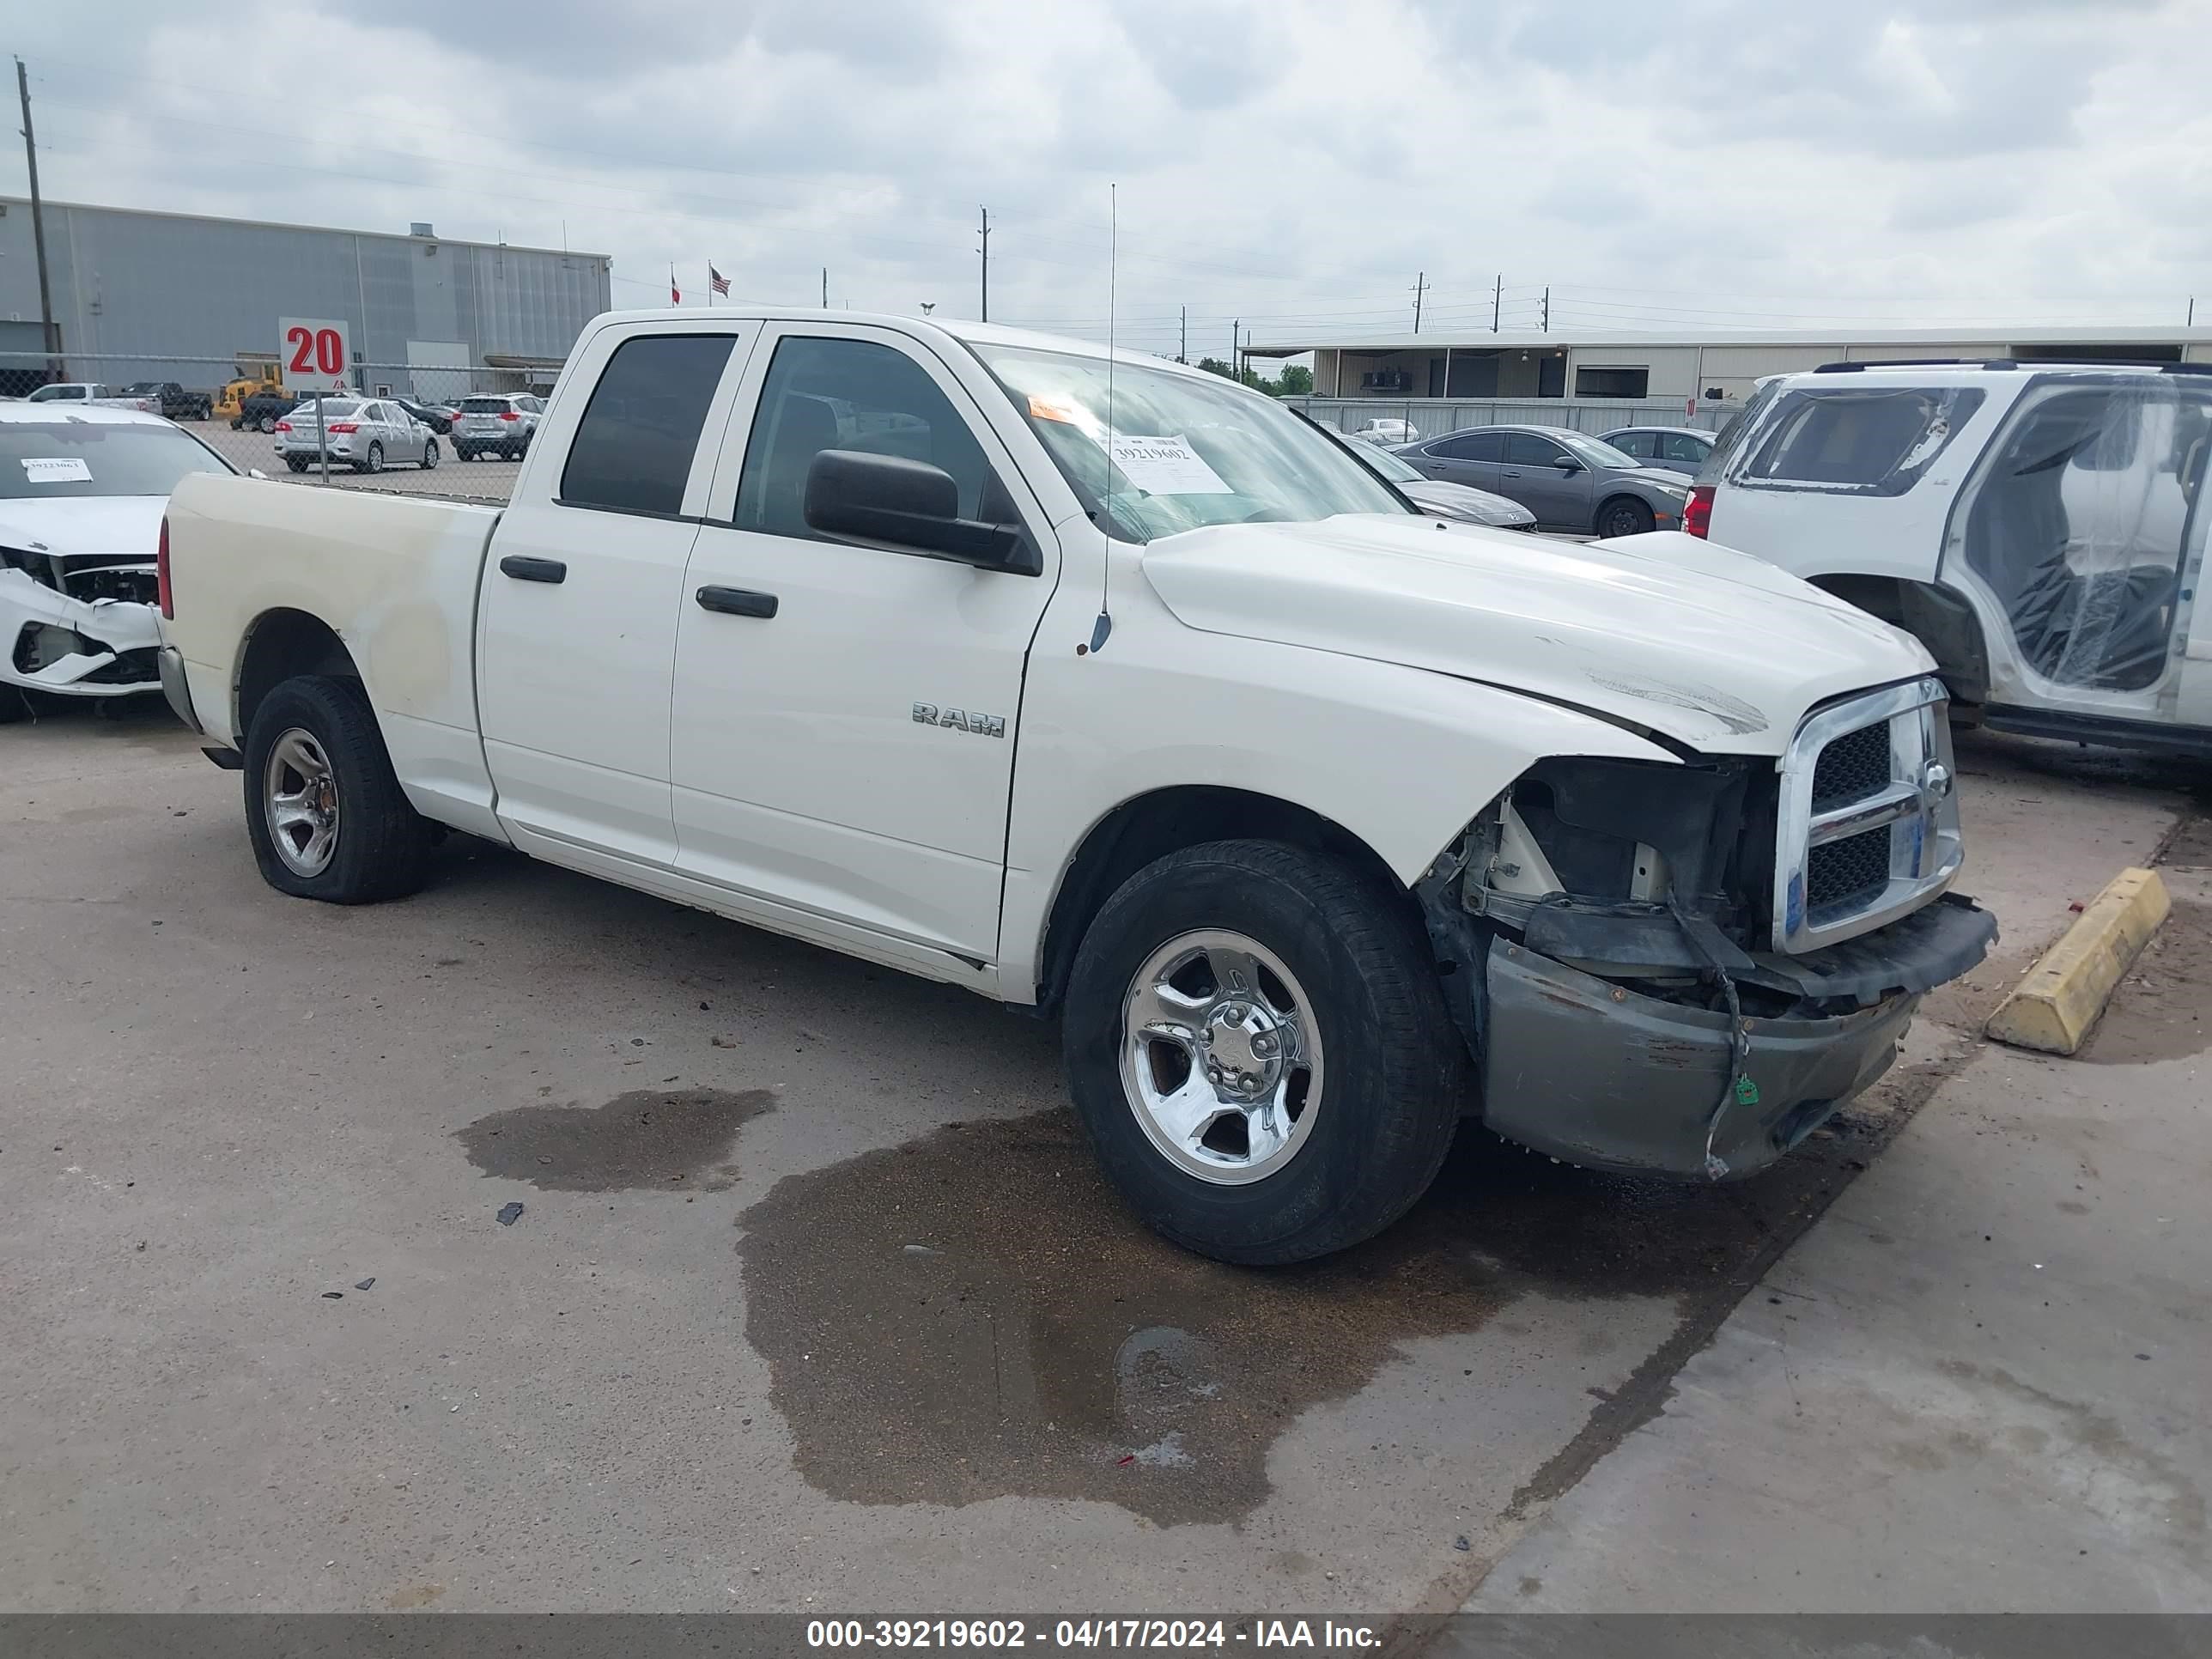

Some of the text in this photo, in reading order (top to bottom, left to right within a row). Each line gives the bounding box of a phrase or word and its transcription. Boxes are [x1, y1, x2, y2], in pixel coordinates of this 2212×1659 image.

[288, 326, 344, 375] 20
[1687, 398, 1696, 416] 10
[1115, 447, 1190, 460] 39219602
[912, 701, 1006, 738] RAM
